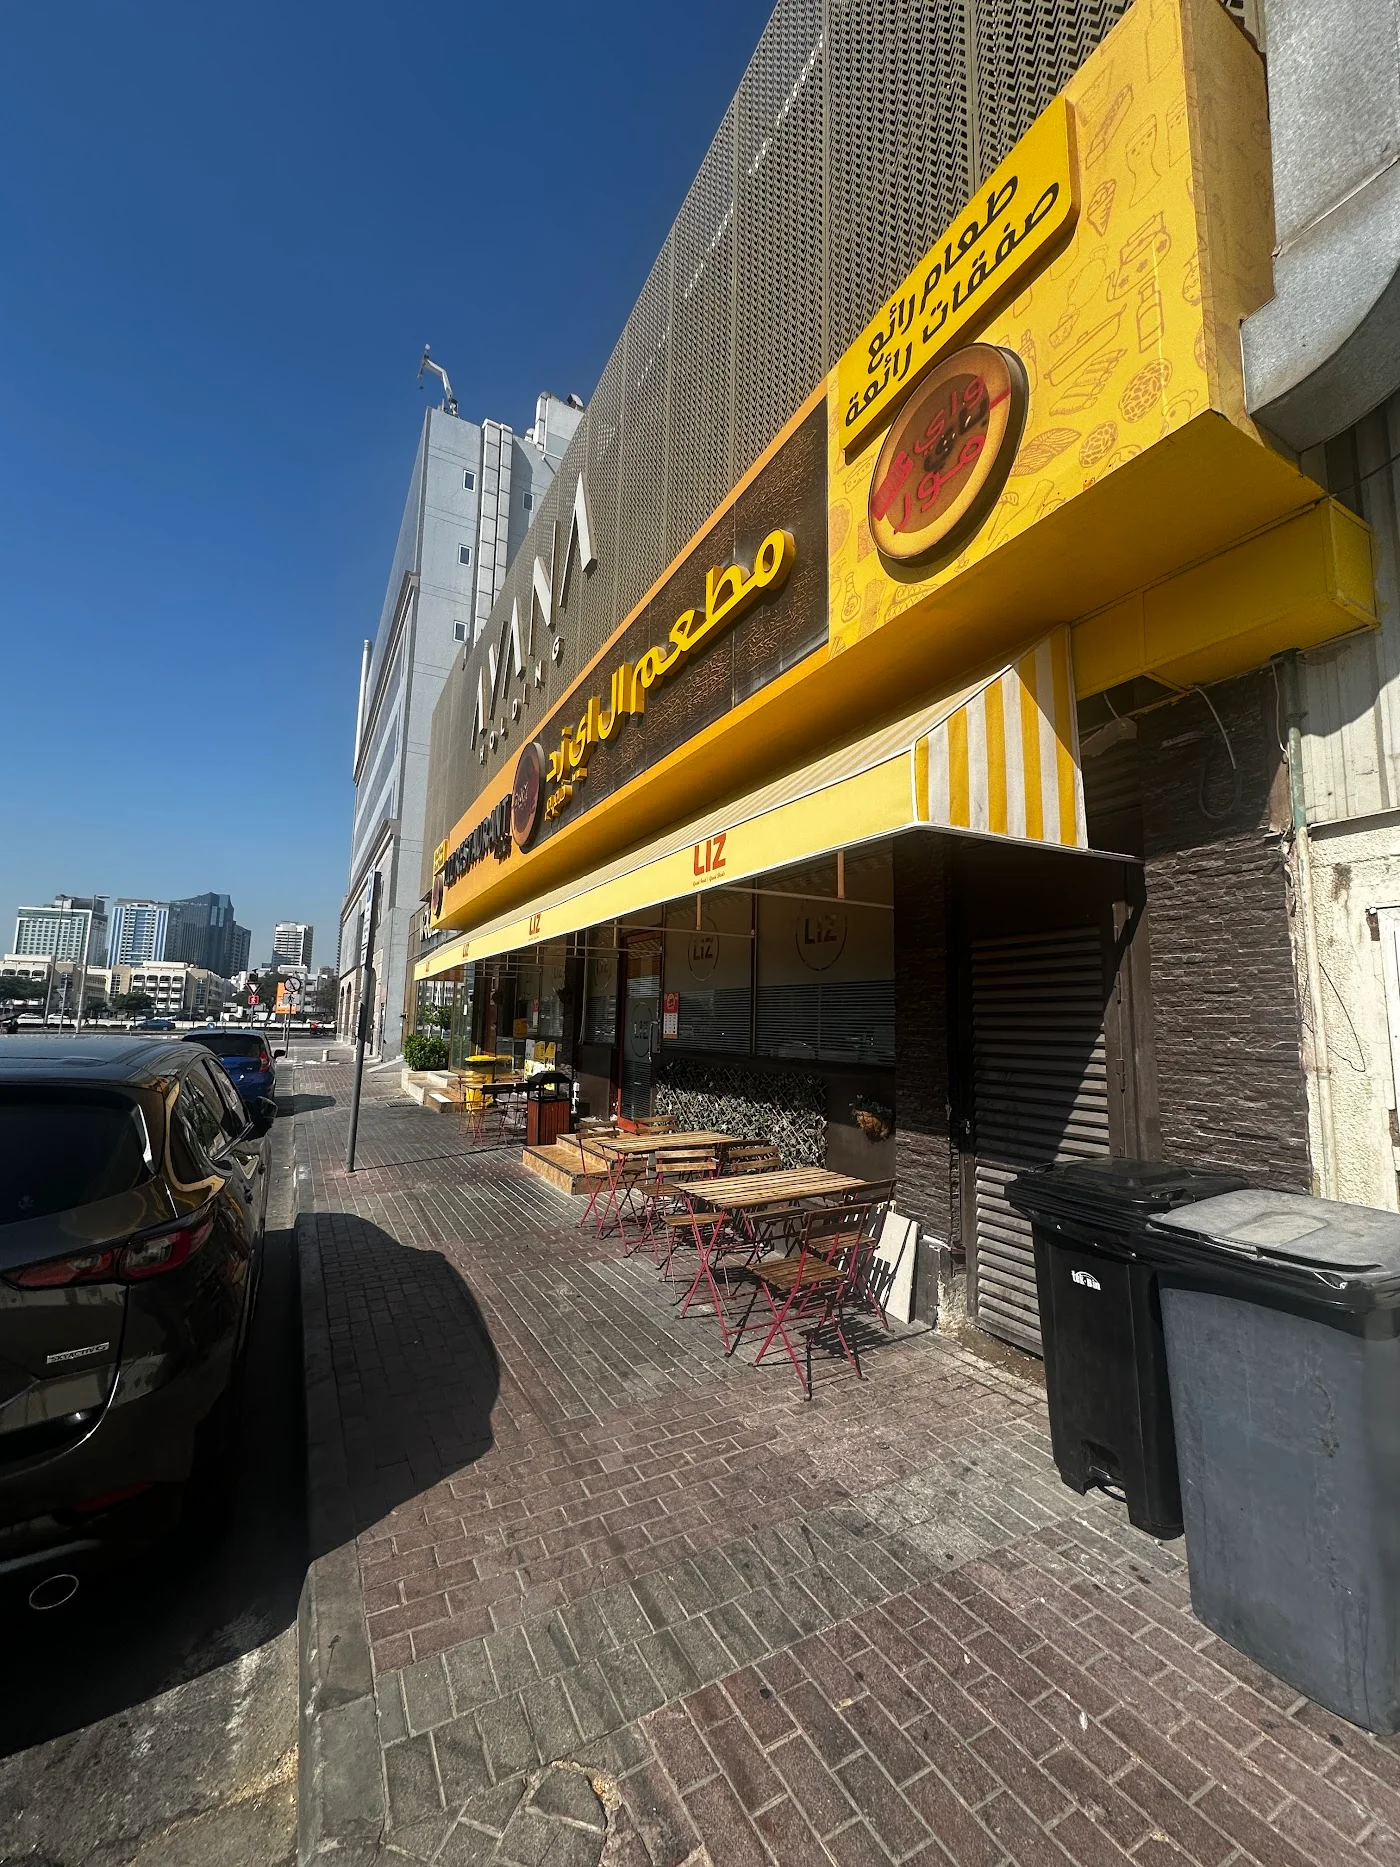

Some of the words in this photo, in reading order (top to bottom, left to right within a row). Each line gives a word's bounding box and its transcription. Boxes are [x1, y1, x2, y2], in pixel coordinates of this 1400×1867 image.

[918, 175, 1018, 315] طعام
[922, 182, 1060, 345] صفقات
[867, 293, 916, 375] رائع
[845, 342, 913, 427] رائعة
[630, 528, 795, 716] مطعم
[694, 833, 726, 876] LIZ
[528, 913, 541, 936] LIZ
[693, 937, 714, 961] LIZ
[804, 914, 837, 945] LIZ
